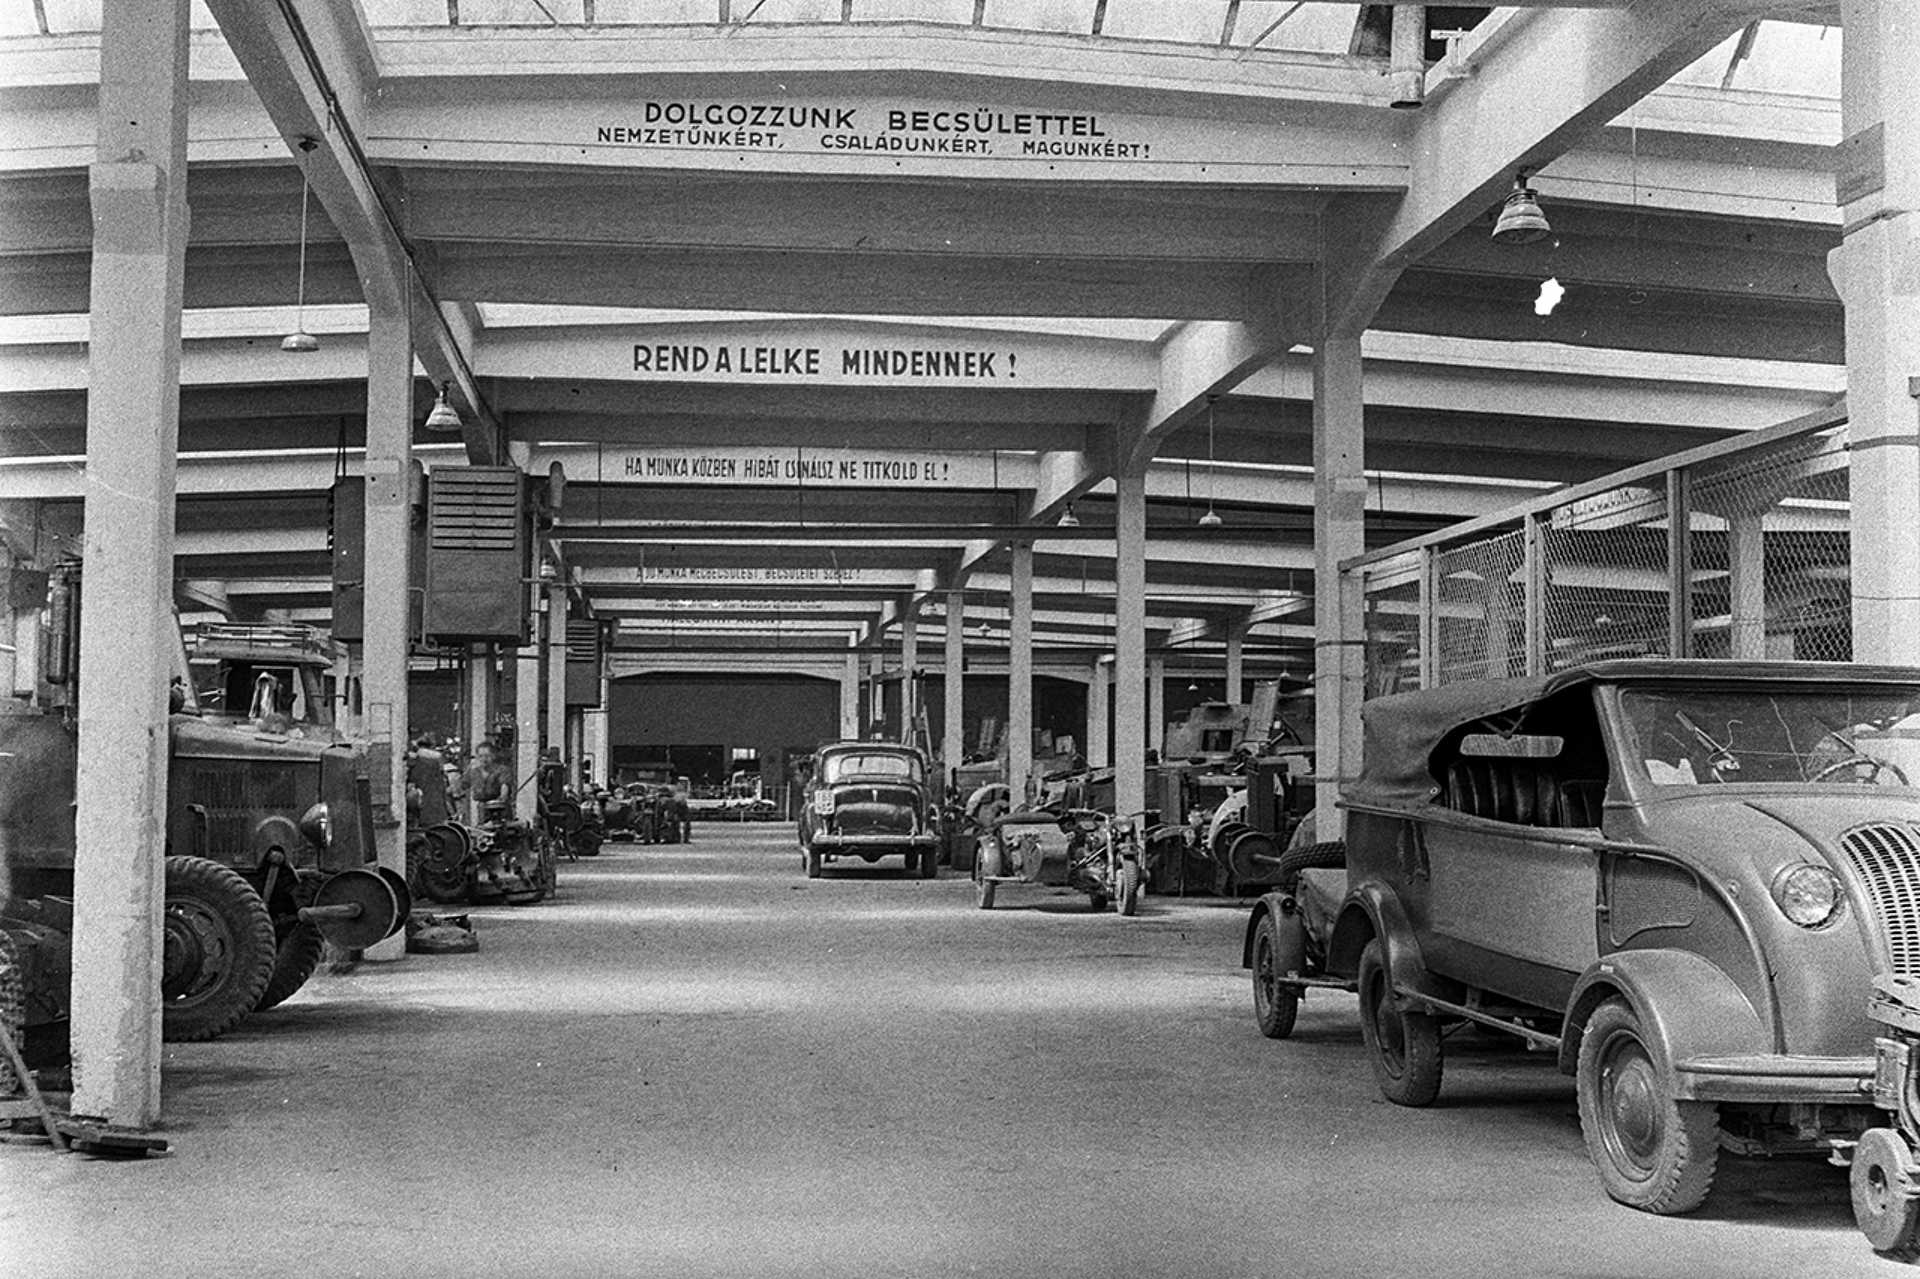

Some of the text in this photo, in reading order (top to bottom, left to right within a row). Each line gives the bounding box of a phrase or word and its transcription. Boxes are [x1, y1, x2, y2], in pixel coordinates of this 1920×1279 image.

[645, 101, 1105, 137] DOLGOZZUNK BECSÜLETTEL
[820, 131, 993, 155] CSALÁDUNKÉRT,
[1023, 139, 1150, 158] MAGUNKÉRT!
[633, 344, 709, 372] REND
[715, 346, 732, 373] A
[740, 347, 820, 375] LELKE
[625, 457, 643, 476] HA
[647, 457, 688, 477] MUNKA
[692, 455, 736, 478] KÖZBEN
[744, 455, 780, 478] HIBÁT
[785, 455, 834, 480] CSINÁLSZ
[839, 460, 857, 480] NE
[862, 461, 918, 481] TITKOLD
